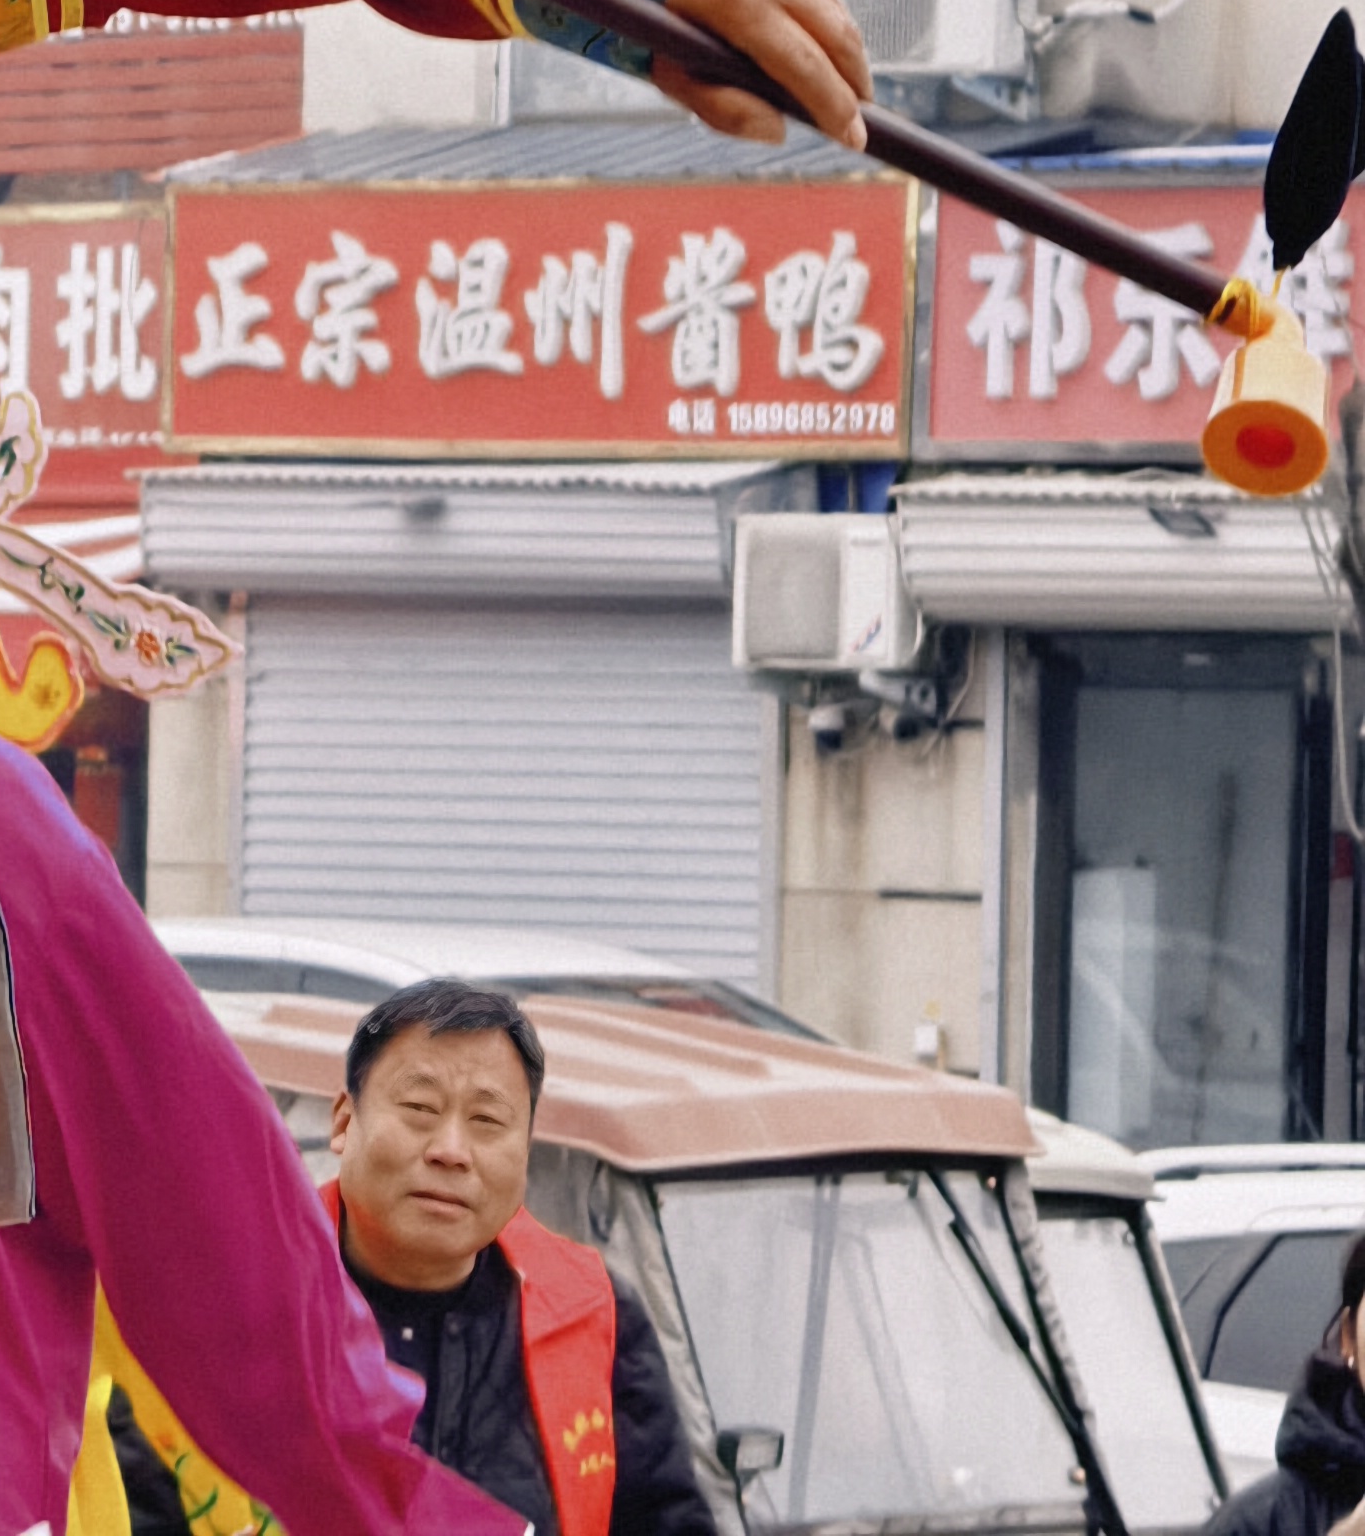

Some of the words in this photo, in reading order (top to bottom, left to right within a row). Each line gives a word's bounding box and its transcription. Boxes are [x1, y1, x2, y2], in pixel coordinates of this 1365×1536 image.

[179, 222, 885, 400] 正宗温州酱鸭
